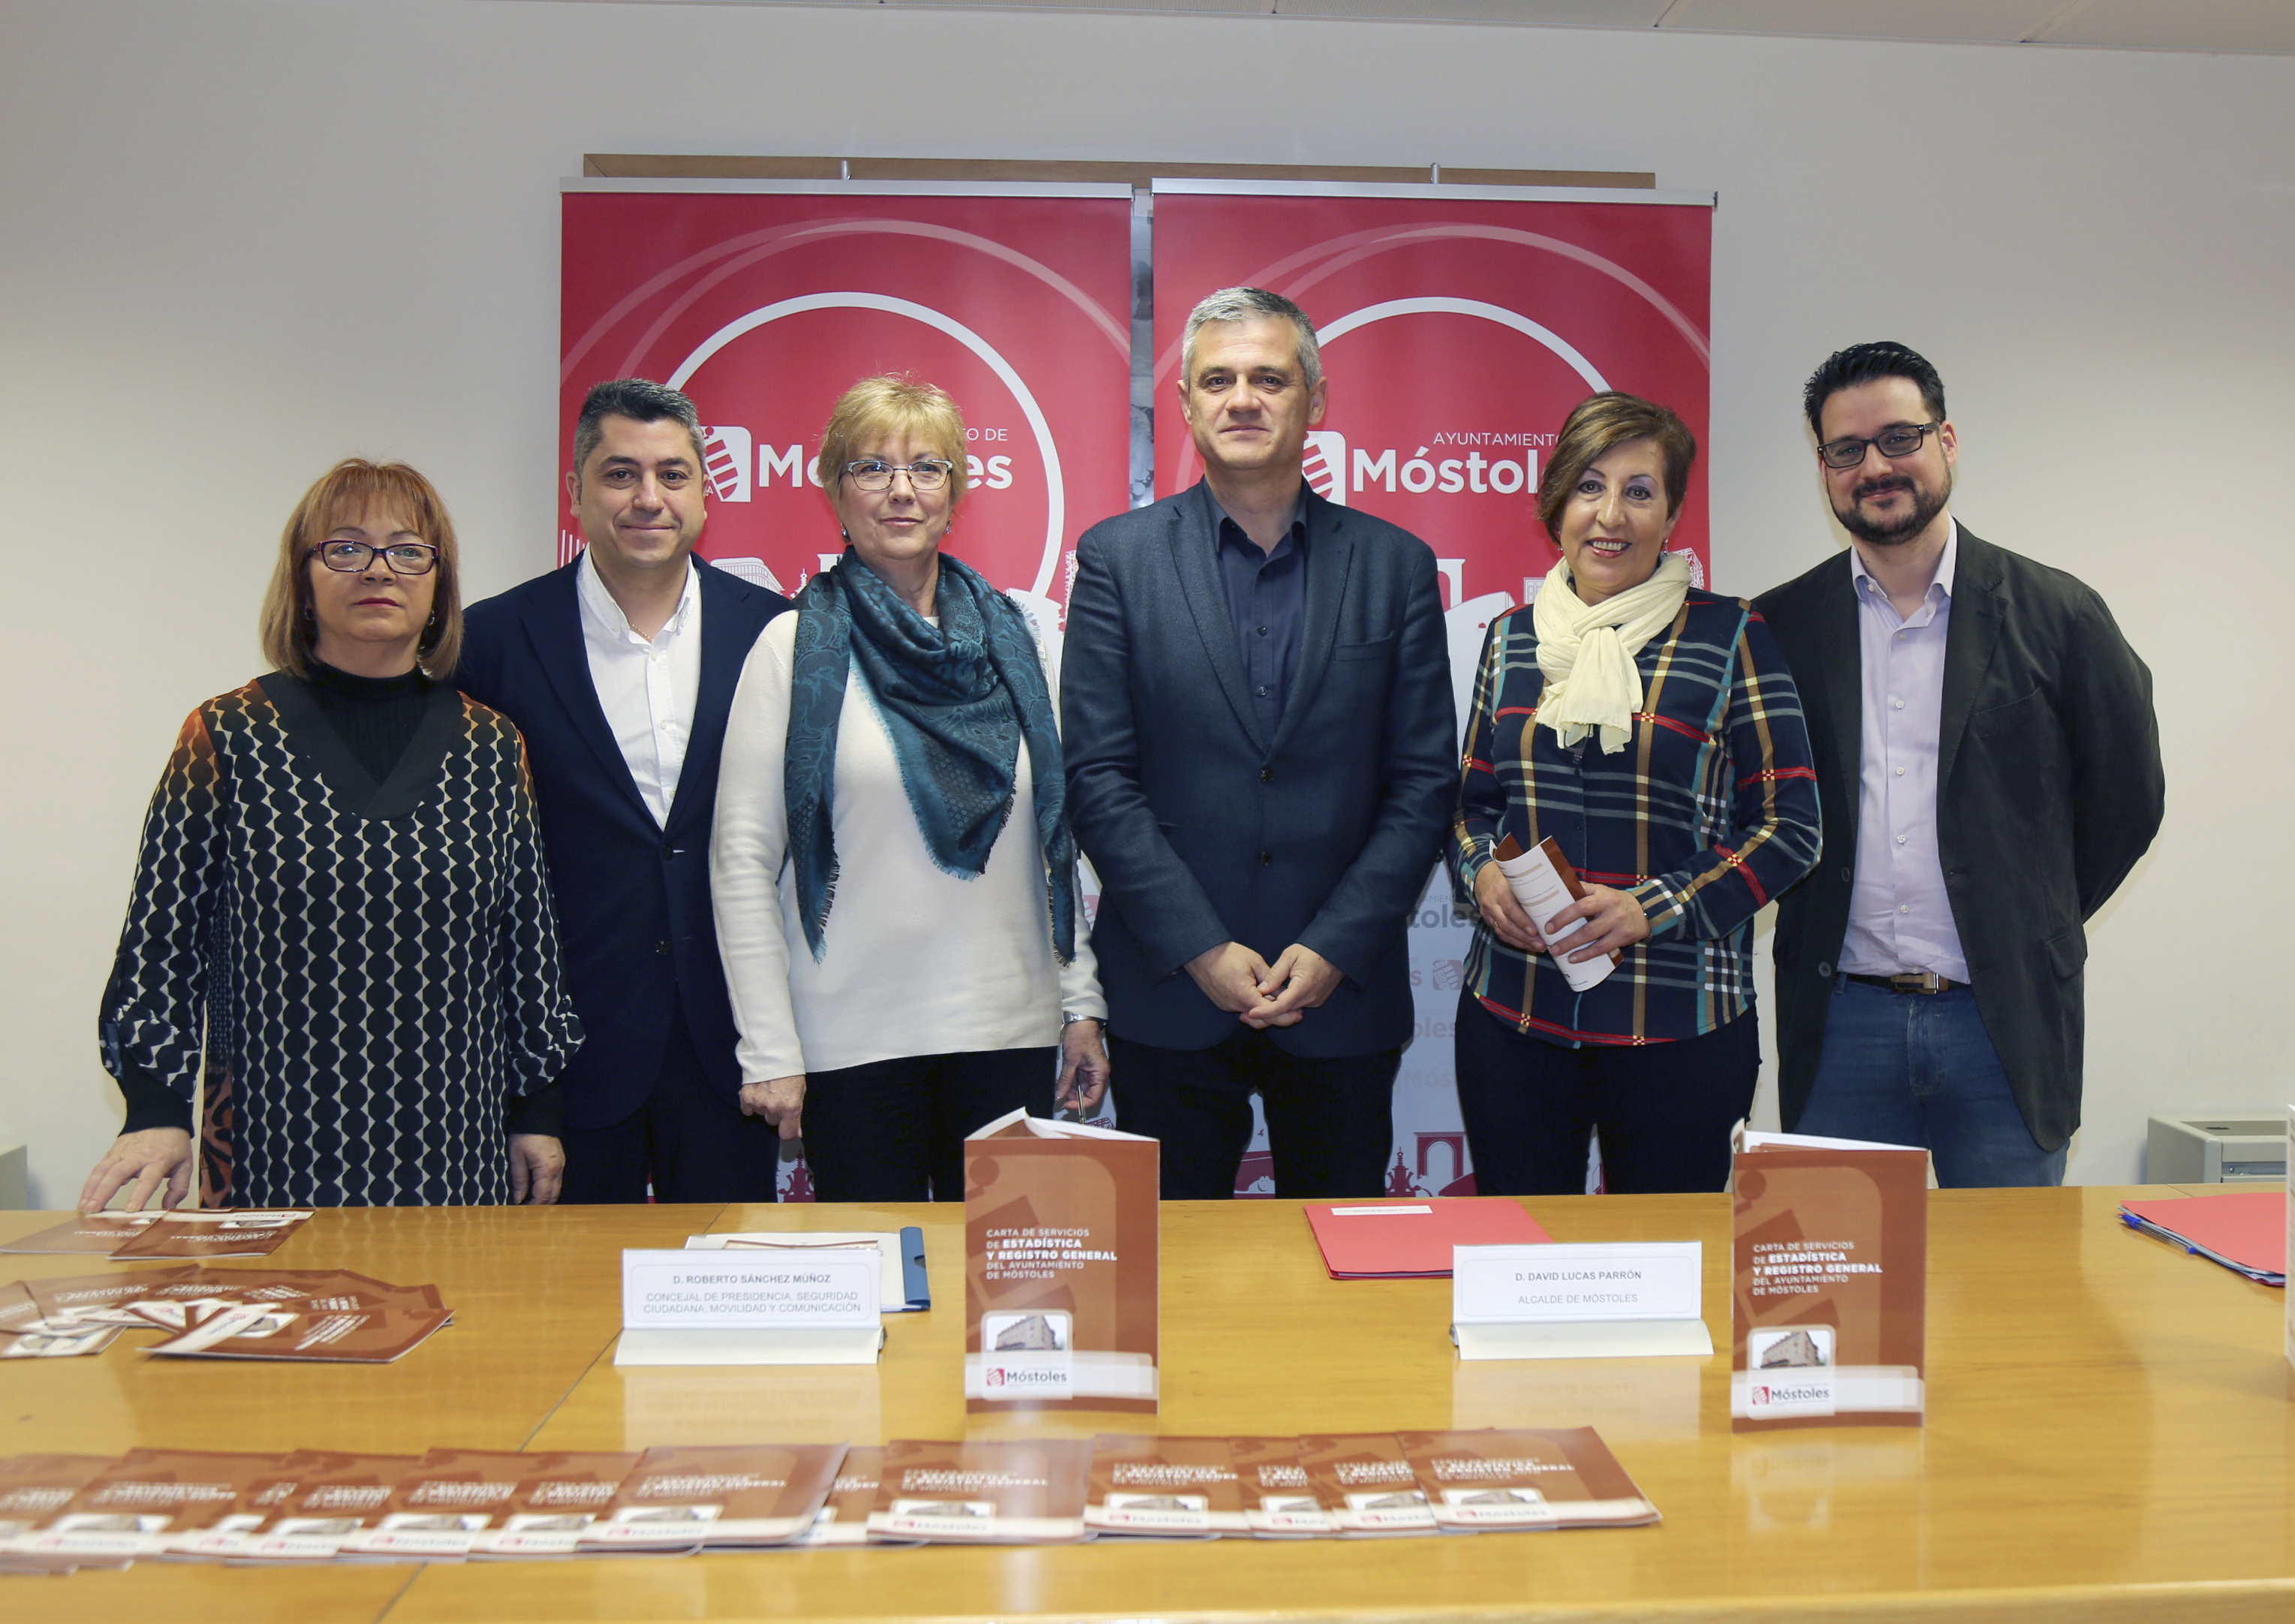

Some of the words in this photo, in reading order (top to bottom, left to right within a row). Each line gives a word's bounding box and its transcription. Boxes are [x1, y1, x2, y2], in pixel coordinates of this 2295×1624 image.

[985, 427, 1008, 441] DE
[1433, 432, 1559, 446] AYUNTAMIENT
[1353, 444, 1544, 494] Móstol
[986, 1228, 1019, 1237] CARTA
[1022, 1228, 1036, 1237] DE
[1038, 1228, 1089, 1237] SERVICIOS
[986, 1240, 1000, 1249] DE
[1002, 1237, 1083, 1249] ESTADÍSTICA
[1753, 1243, 1785, 1252] CARTA
[1787, 1243, 1800, 1251] DE
[1803, 1241, 1854, 1251] SERVICIOS
[986, 1250, 995, 1261] Y
[998, 1250, 1059, 1260] REGISTRO
[1062, 1251, 1118, 1261] GENERAL
[1753, 1256, 1766, 1264] DE
[1768, 1251, 1847, 1264] ESTADÍSTICA
[986, 1261, 1005, 1270] DEL
[1008, 1261, 1084, 1270] AYUNTAMIENTO
[1752, 1267, 1761, 1276] Y
[1763, 1264, 1823, 1276] REGISTRO
[1826, 1263, 1883, 1273] GENERAL
[673, 1276, 683, 1284] D.
[686, 1276, 738, 1284] ROBERTO
[741, 1273, 791, 1284] SÁNCHEZ
[986, 1271, 999, 1279] DE
[1002, 1270, 1055, 1279] MÓSTOLES
[1515, 1273, 1525, 1281] D.
[1528, 1273, 1559, 1281] DAVID
[1562, 1272, 1596, 1280] LUCAS
[1599, 1270, 1642, 1279] PARRÓN
[1753, 1277, 1772, 1286] DEL
[1774, 1275, 1848, 1285] AYUNTAMIENTO
[1752, 1287, 1766, 1296] DE
[1768, 1285, 1819, 1294] MÓSTOLES
[646, 1293, 701, 1302] CONCEJAL
[704, 1293, 718, 1301] DE
[721, 1292, 794, 1302] PRESIDENCIA,
[797, 1292, 858, 1300] SEGURIDAD
[1518, 1295, 1564, 1304] ALCALDE
[1567, 1295, 1580, 1303] DE
[1583, 1294, 1638, 1303] MÓSTOLES
[643, 1305, 707, 1314] CIUDADANA,
[709, 1304, 767, 1312] MOVILIDAD
[779, 1303, 861, 1312] COMUNICACIÓN
[1007, 1370, 1067, 1382] Móstoles
[1771, 1387, 1830, 1400] Móstoles
